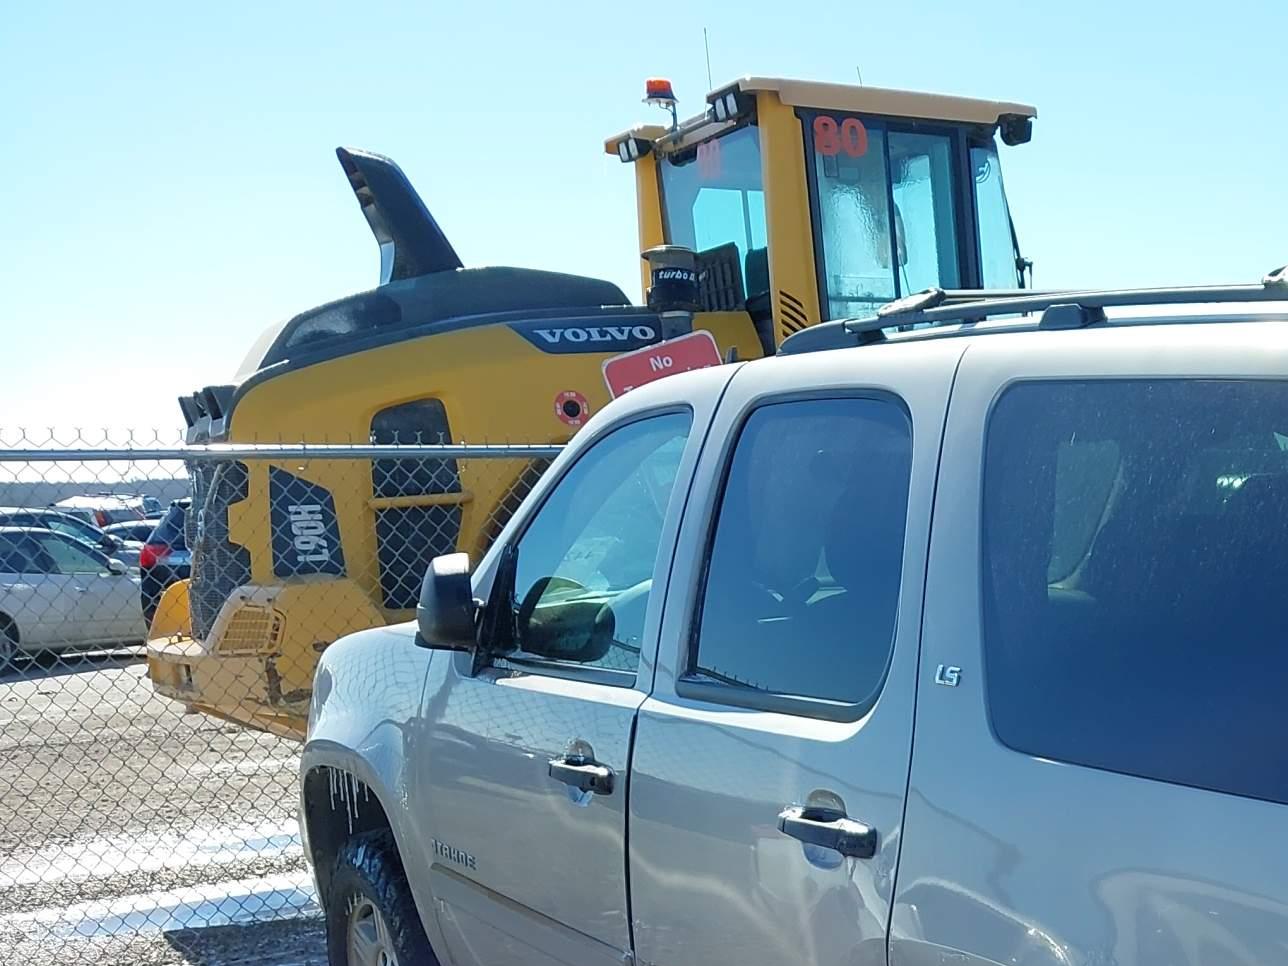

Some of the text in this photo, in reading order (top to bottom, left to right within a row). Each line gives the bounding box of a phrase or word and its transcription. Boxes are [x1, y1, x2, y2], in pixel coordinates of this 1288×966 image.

[813, 115, 868, 157] 80
[659, 270, 689, 280] turbo
[533, 325, 656, 344] VOLVO
[648, 355, 673, 372] No
[288, 504, 329, 562] L90H
[935, 664, 961, 687] LS
[431, 839, 477, 871] TAHOE
